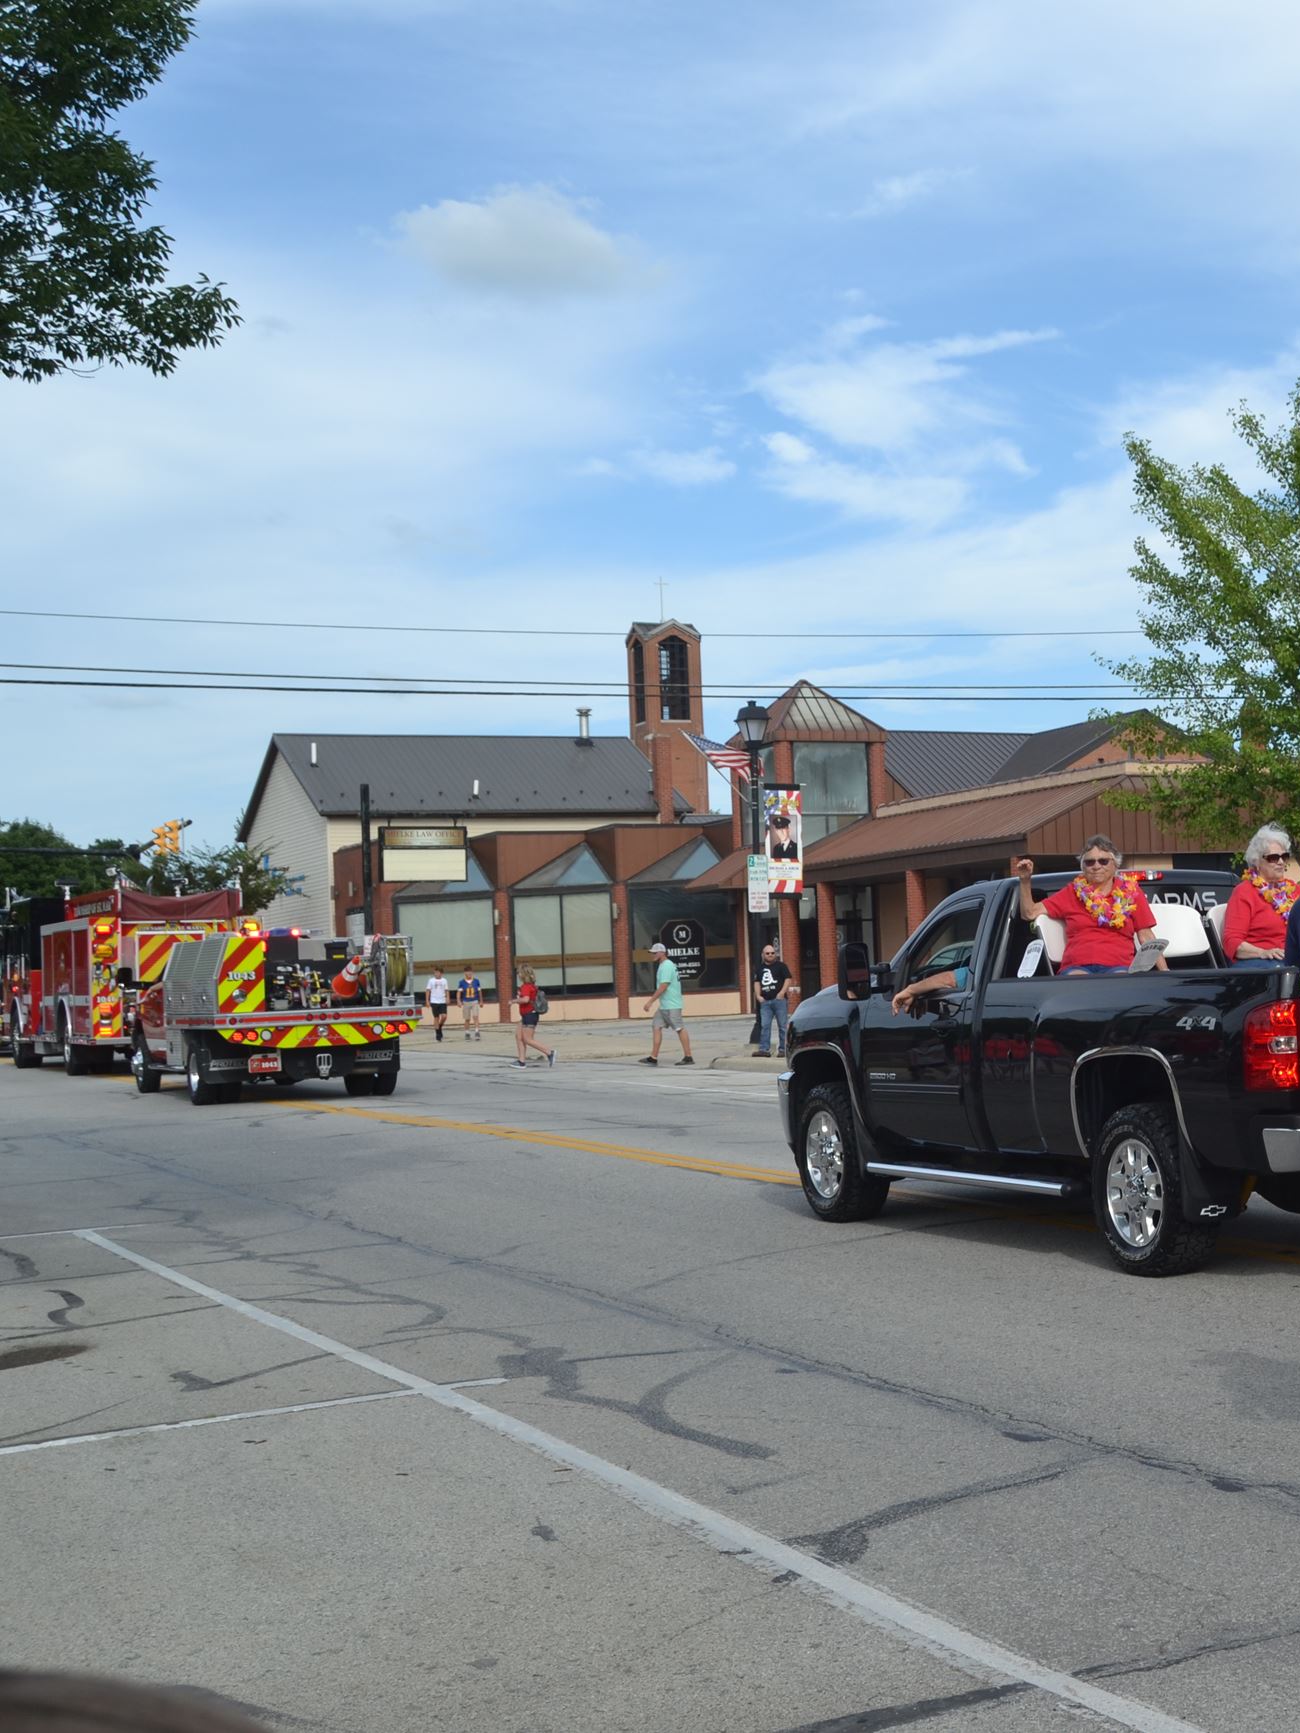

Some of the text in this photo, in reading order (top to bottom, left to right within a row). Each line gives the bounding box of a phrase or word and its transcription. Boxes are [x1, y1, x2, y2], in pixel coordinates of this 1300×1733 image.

[416, 830, 433, 838] LAW
[1145, 891, 1218, 911] ARMS
[678, 930, 686, 938] M
[667, 947, 700, 957] MIELKE
[227, 970, 256, 981] 1043
